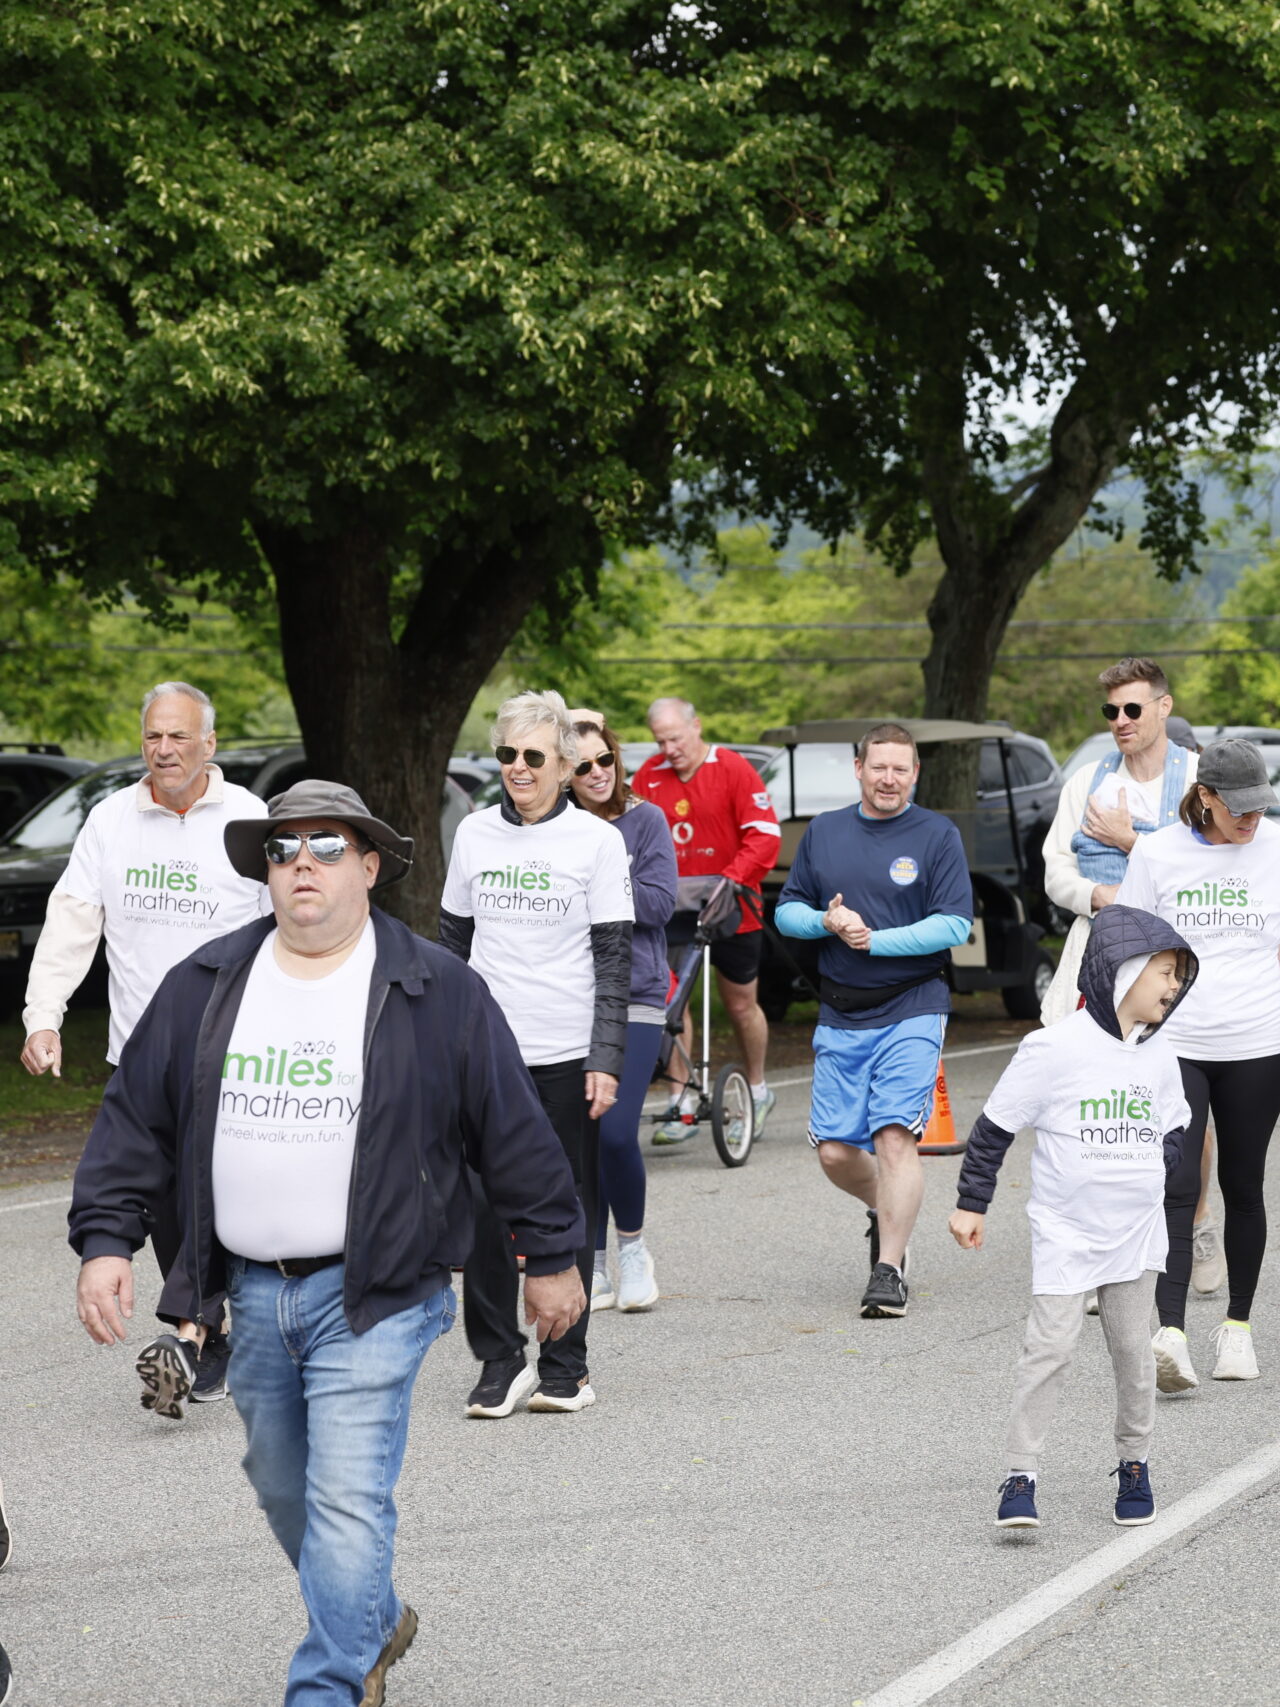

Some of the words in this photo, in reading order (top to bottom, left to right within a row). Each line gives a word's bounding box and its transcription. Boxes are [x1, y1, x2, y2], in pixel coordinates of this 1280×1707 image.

[125, 862, 197, 892] miles
[200, 884, 213, 894] for
[480, 865, 550, 891] miles
[123, 892, 219, 920] matheny
[478, 891, 572, 916] matheny
[1177, 882, 1248, 907] miles
[1176, 907, 1270, 931] matheny
[222, 1046, 334, 1087] miles
[337, 1072, 357, 1086] for
[222, 1090, 362, 1126] matheny
[1080, 1089, 1151, 1121] miles
[220, 1125, 345, 1144] wheel.walk.run.fun.
